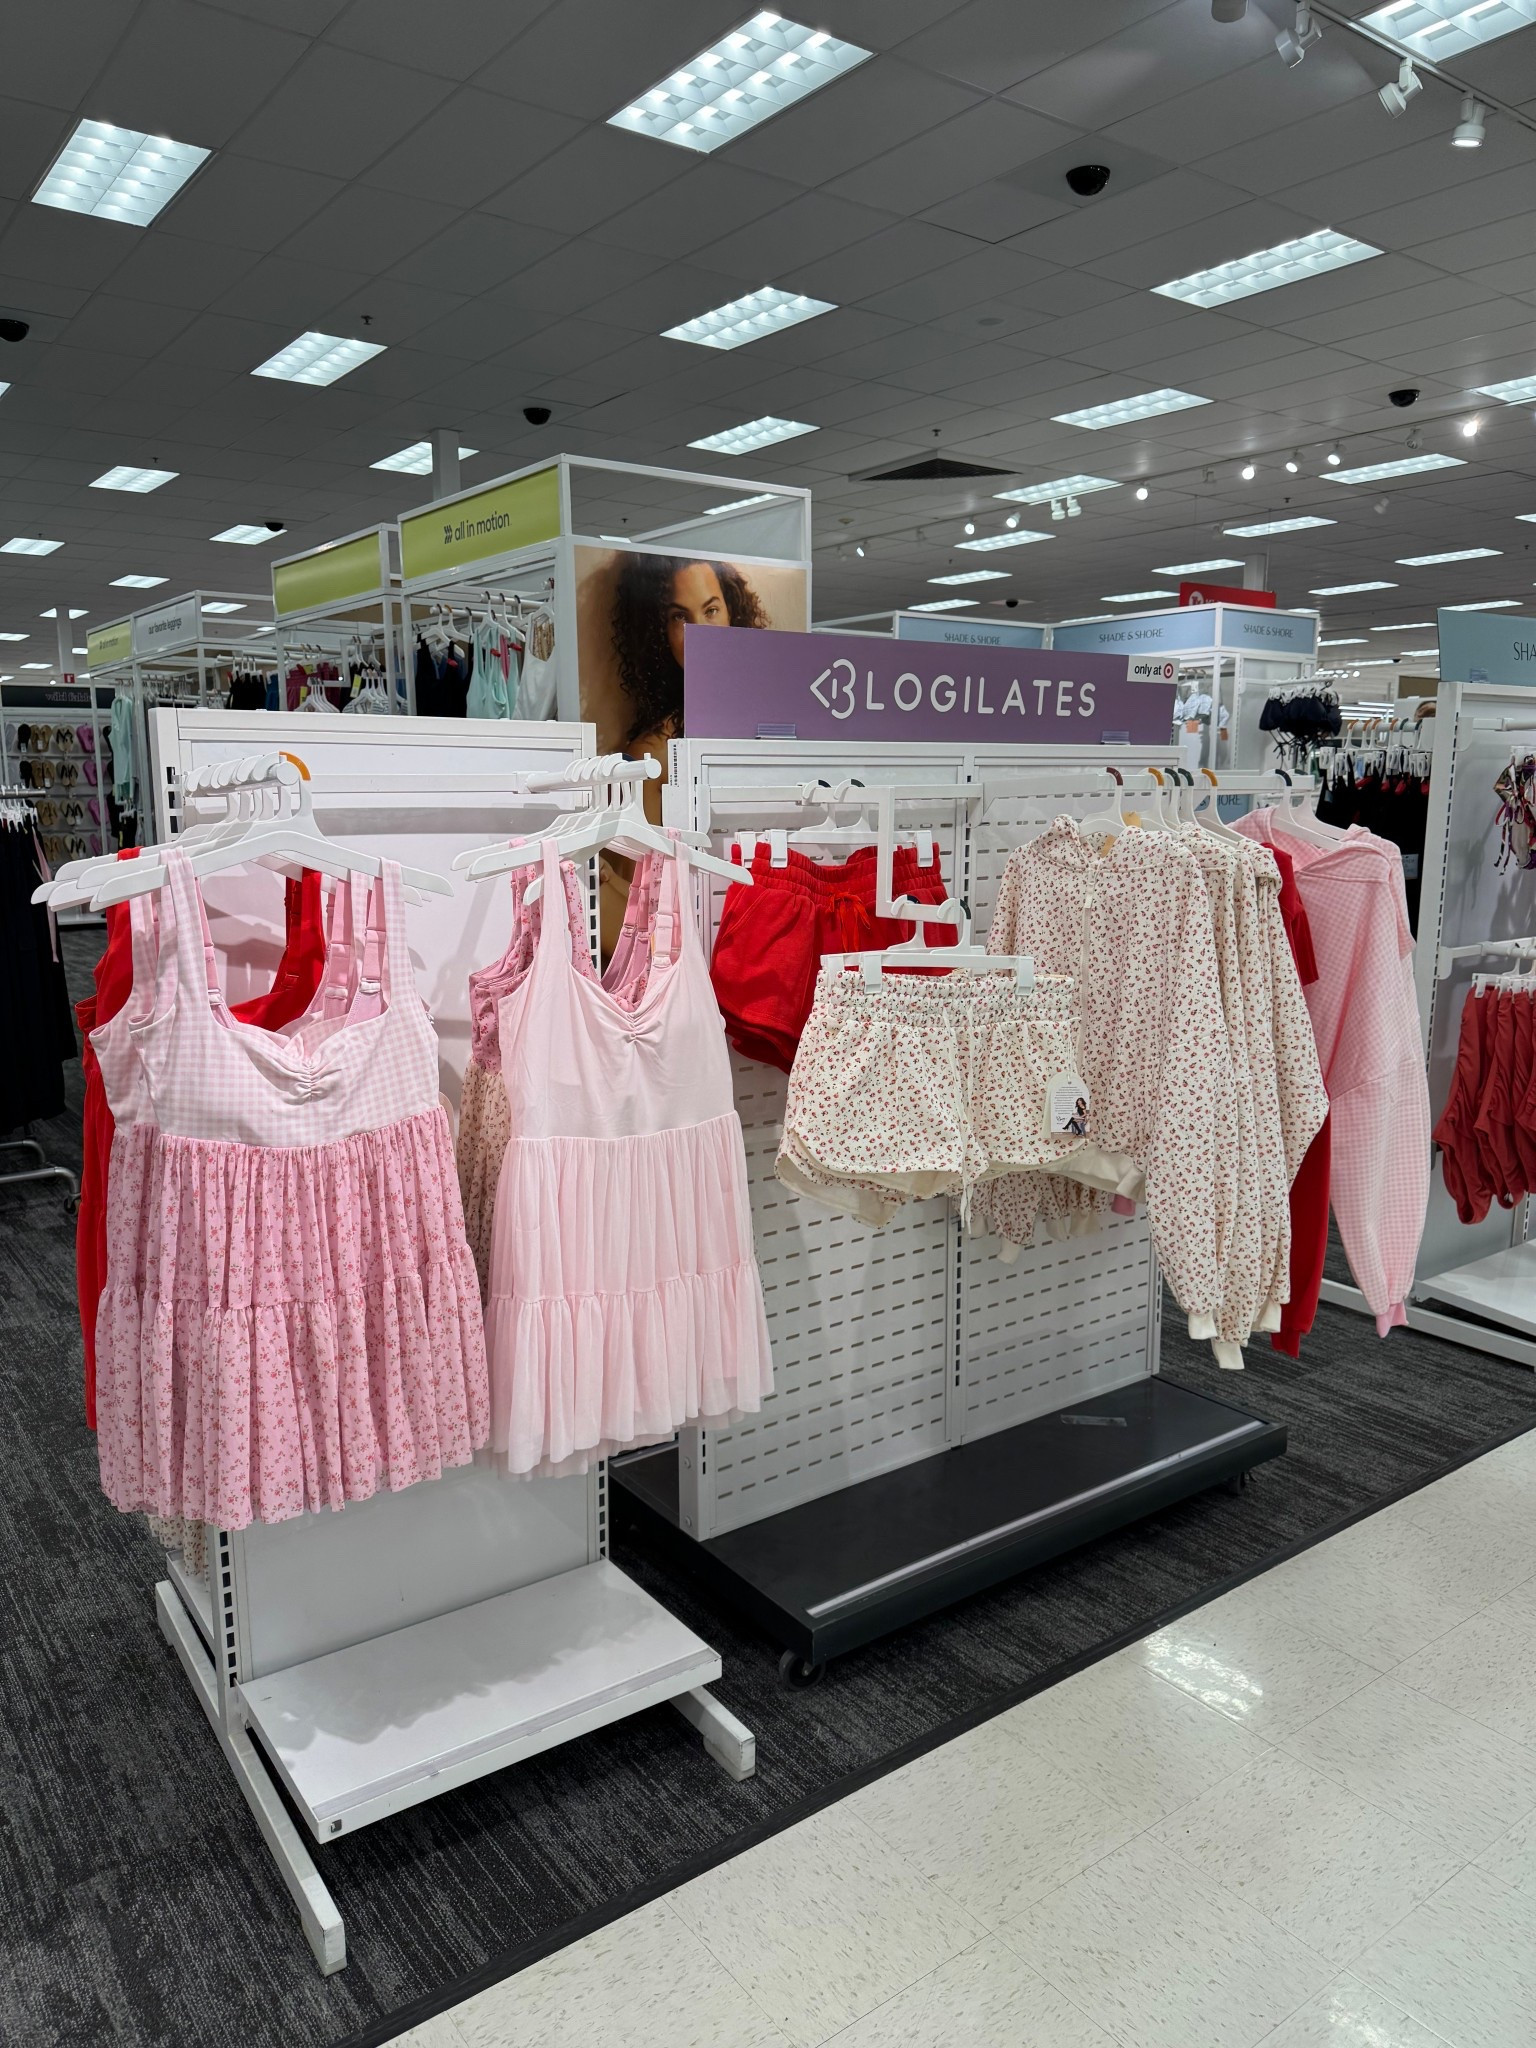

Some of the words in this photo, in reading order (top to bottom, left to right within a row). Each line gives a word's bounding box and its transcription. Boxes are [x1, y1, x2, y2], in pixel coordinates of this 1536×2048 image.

[454, 520, 465, 541] all
[466, 519, 475, 538] in
[476, 510, 510, 536] motion
[1099, 631, 1126, 643] SHADE
[1127, 630, 1133, 640] &
[1134, 627, 1164, 639] SHORE
[1243, 623, 1265, 636] SHADE
[1265, 626, 1271, 636] &
[1271, 627, 1294, 638] SHORE
[944, 632, 969, 643] SHADE
[970, 635, 976, 644] &
[977, 635, 1001, 645] SHORE
[1134, 664, 1153, 677] only
[1153, 665, 1162, 676] at
[809, 658, 1097, 720] BLOGILATES
